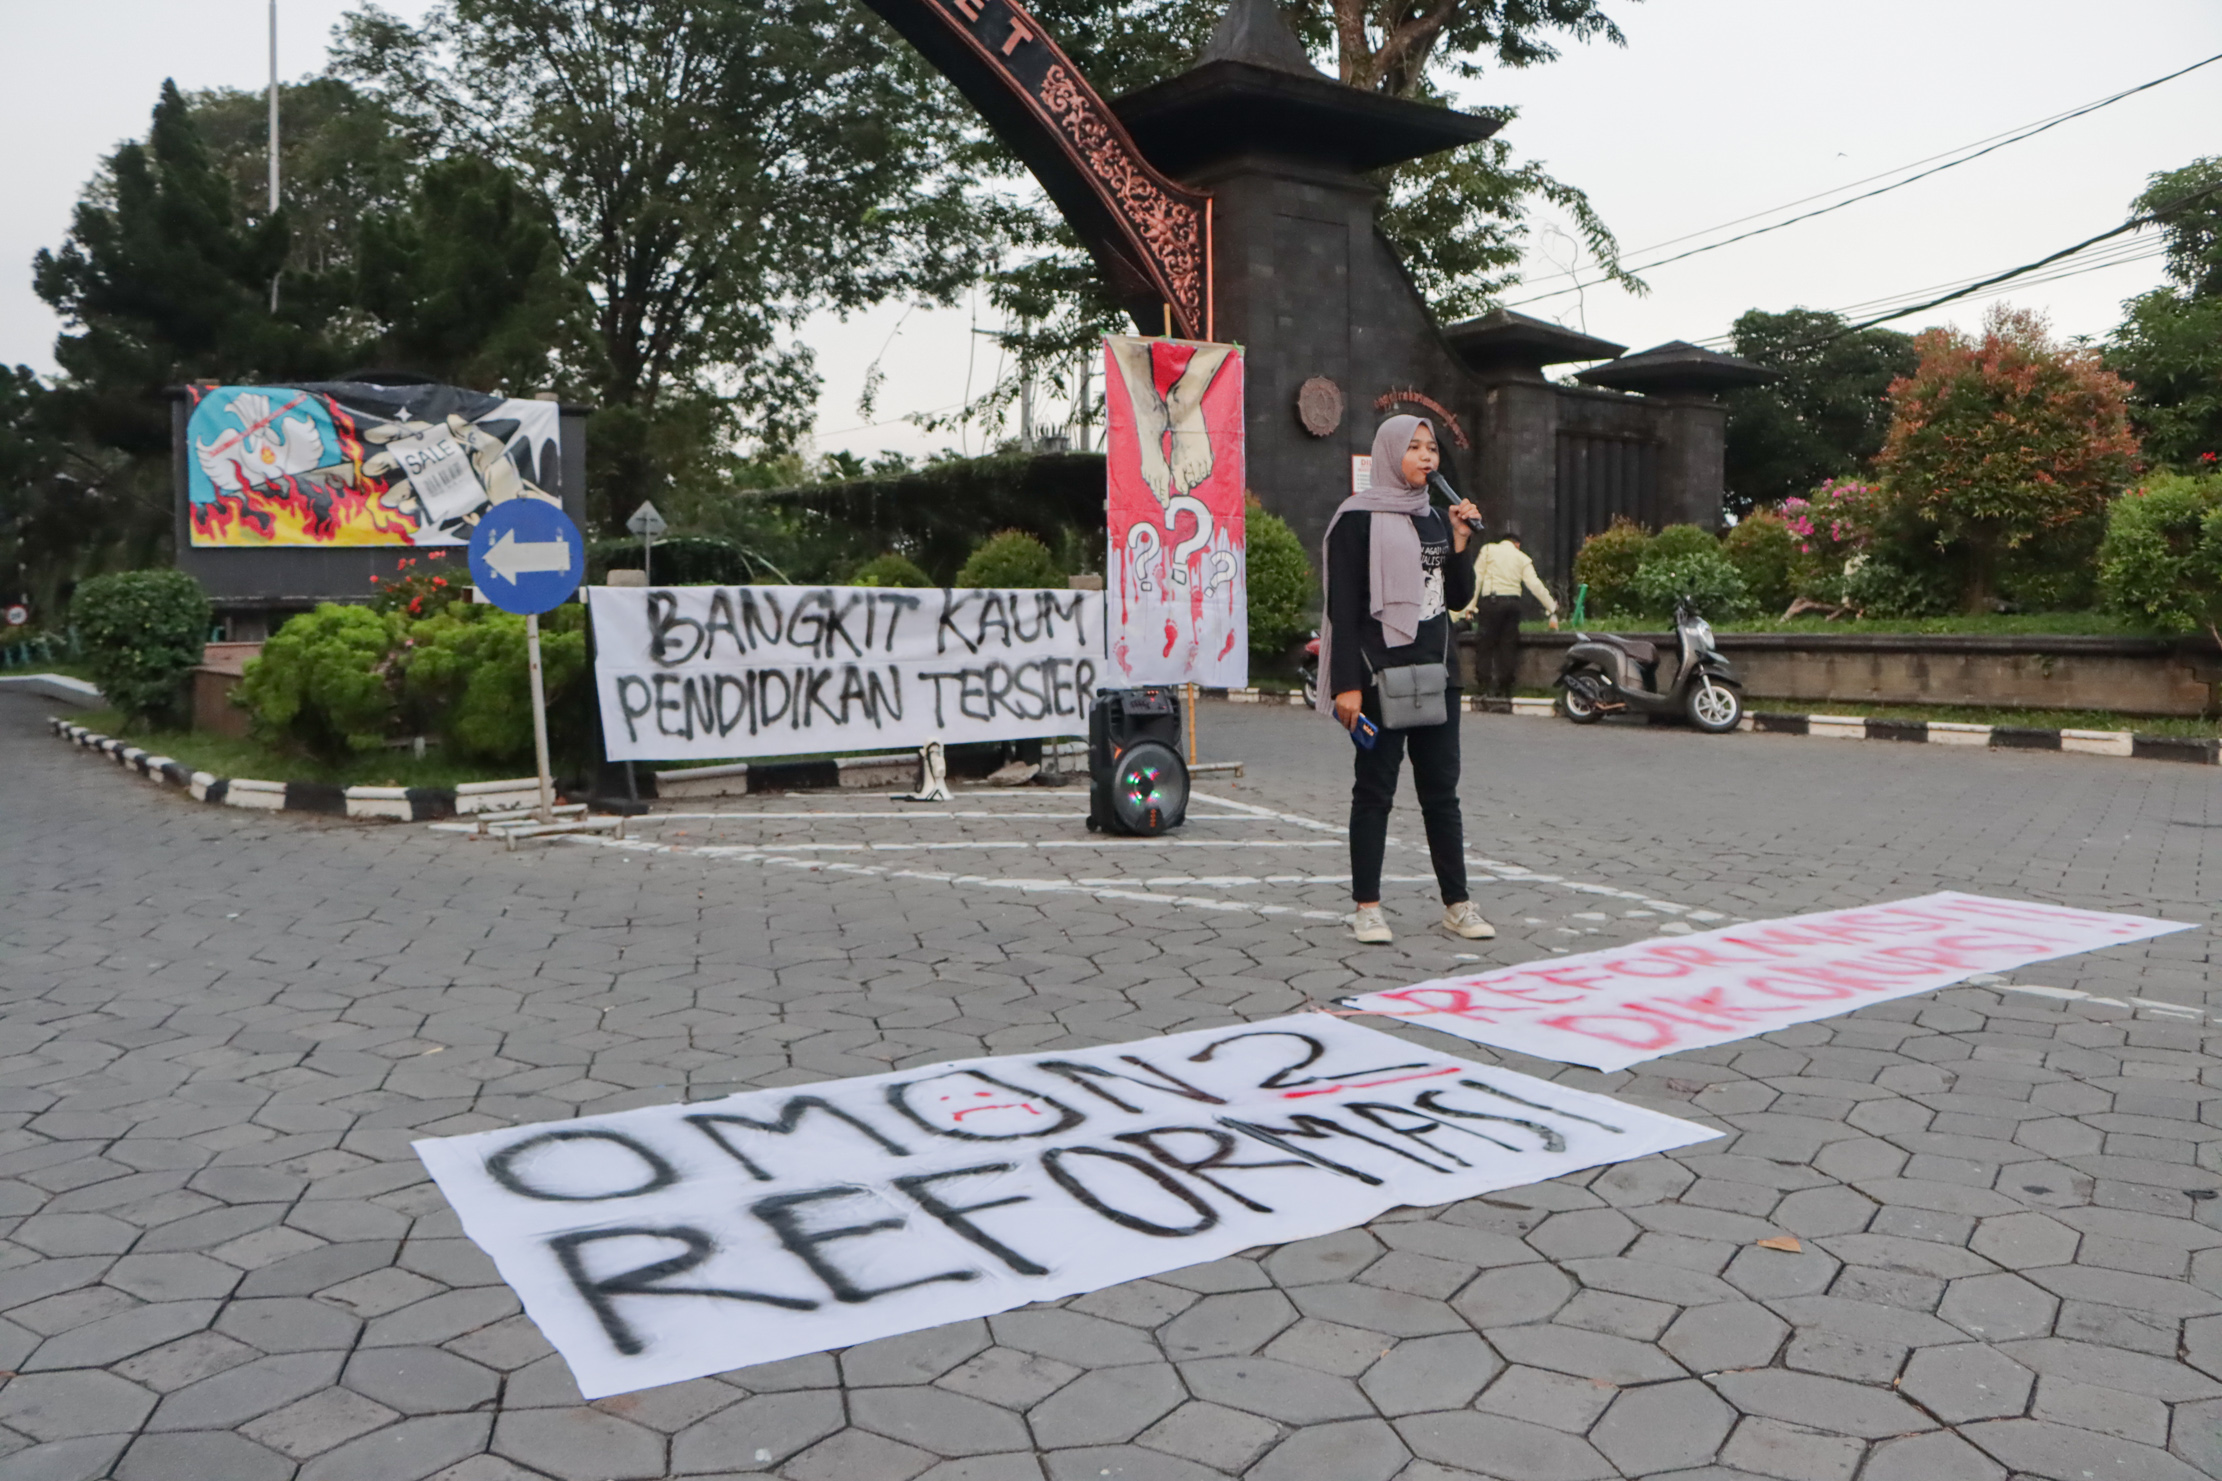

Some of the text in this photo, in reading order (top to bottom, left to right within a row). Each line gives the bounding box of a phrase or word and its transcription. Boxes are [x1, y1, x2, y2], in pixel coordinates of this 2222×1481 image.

[405, 439, 456, 476] SALE
[645, 587, 1086, 667] BANGKIT KAUM
[616, 657, 1097, 743] PENDIDIKAN TERSIER
[1376, 907, 1966, 1025] REFORMASI
[545, 1078, 1626, 1356] REFORMASI
